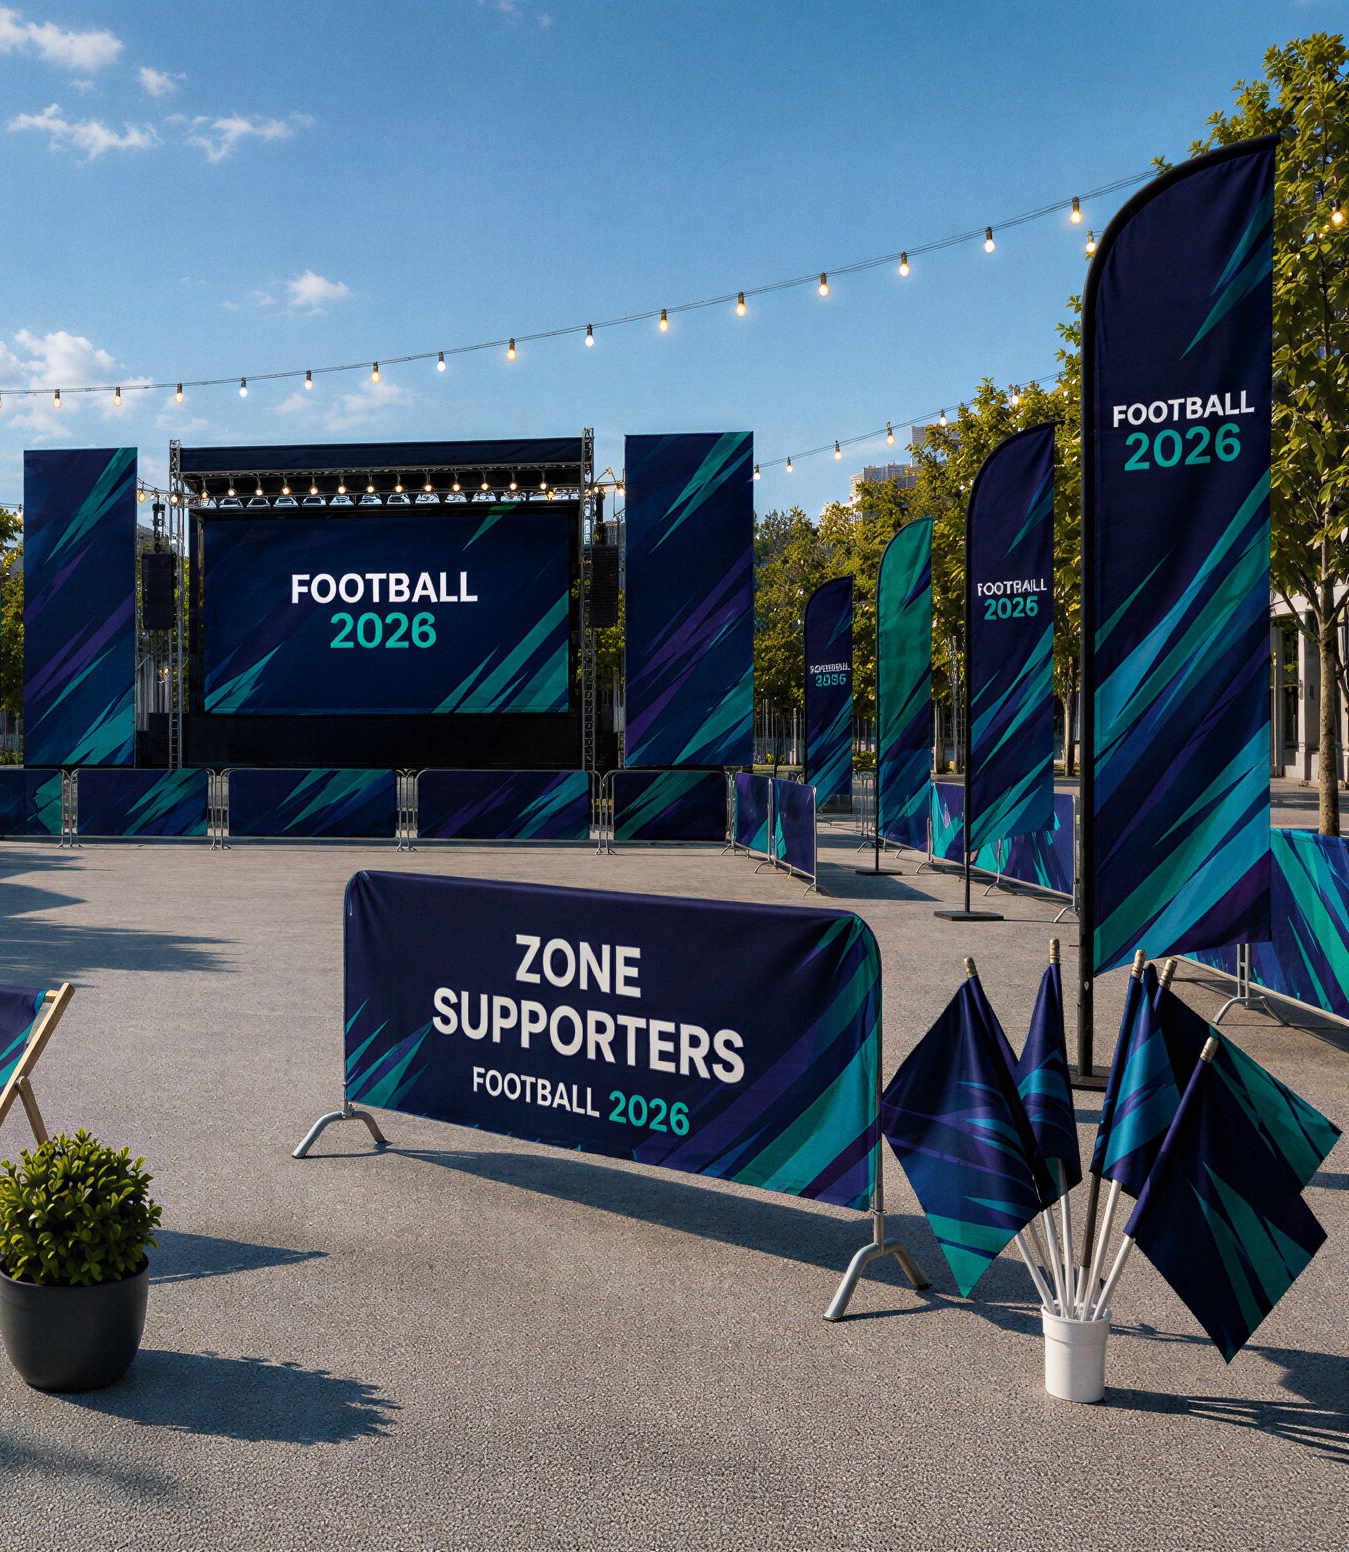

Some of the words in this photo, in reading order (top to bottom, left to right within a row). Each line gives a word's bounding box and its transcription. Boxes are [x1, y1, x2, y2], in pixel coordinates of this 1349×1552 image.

[1113, 390, 1255, 428] FOOTBALL
[1124, 422, 1241, 471] 2026
[291, 571, 478, 604] FOOTBALL
[330, 611, 437, 649] 2026
[515, 934, 642, 998] ZONE
[432, 988, 745, 1083] SUPPORTERS
[473, 1067, 600, 1118] FOOTBALL
[609, 1090, 690, 1136] 2026
